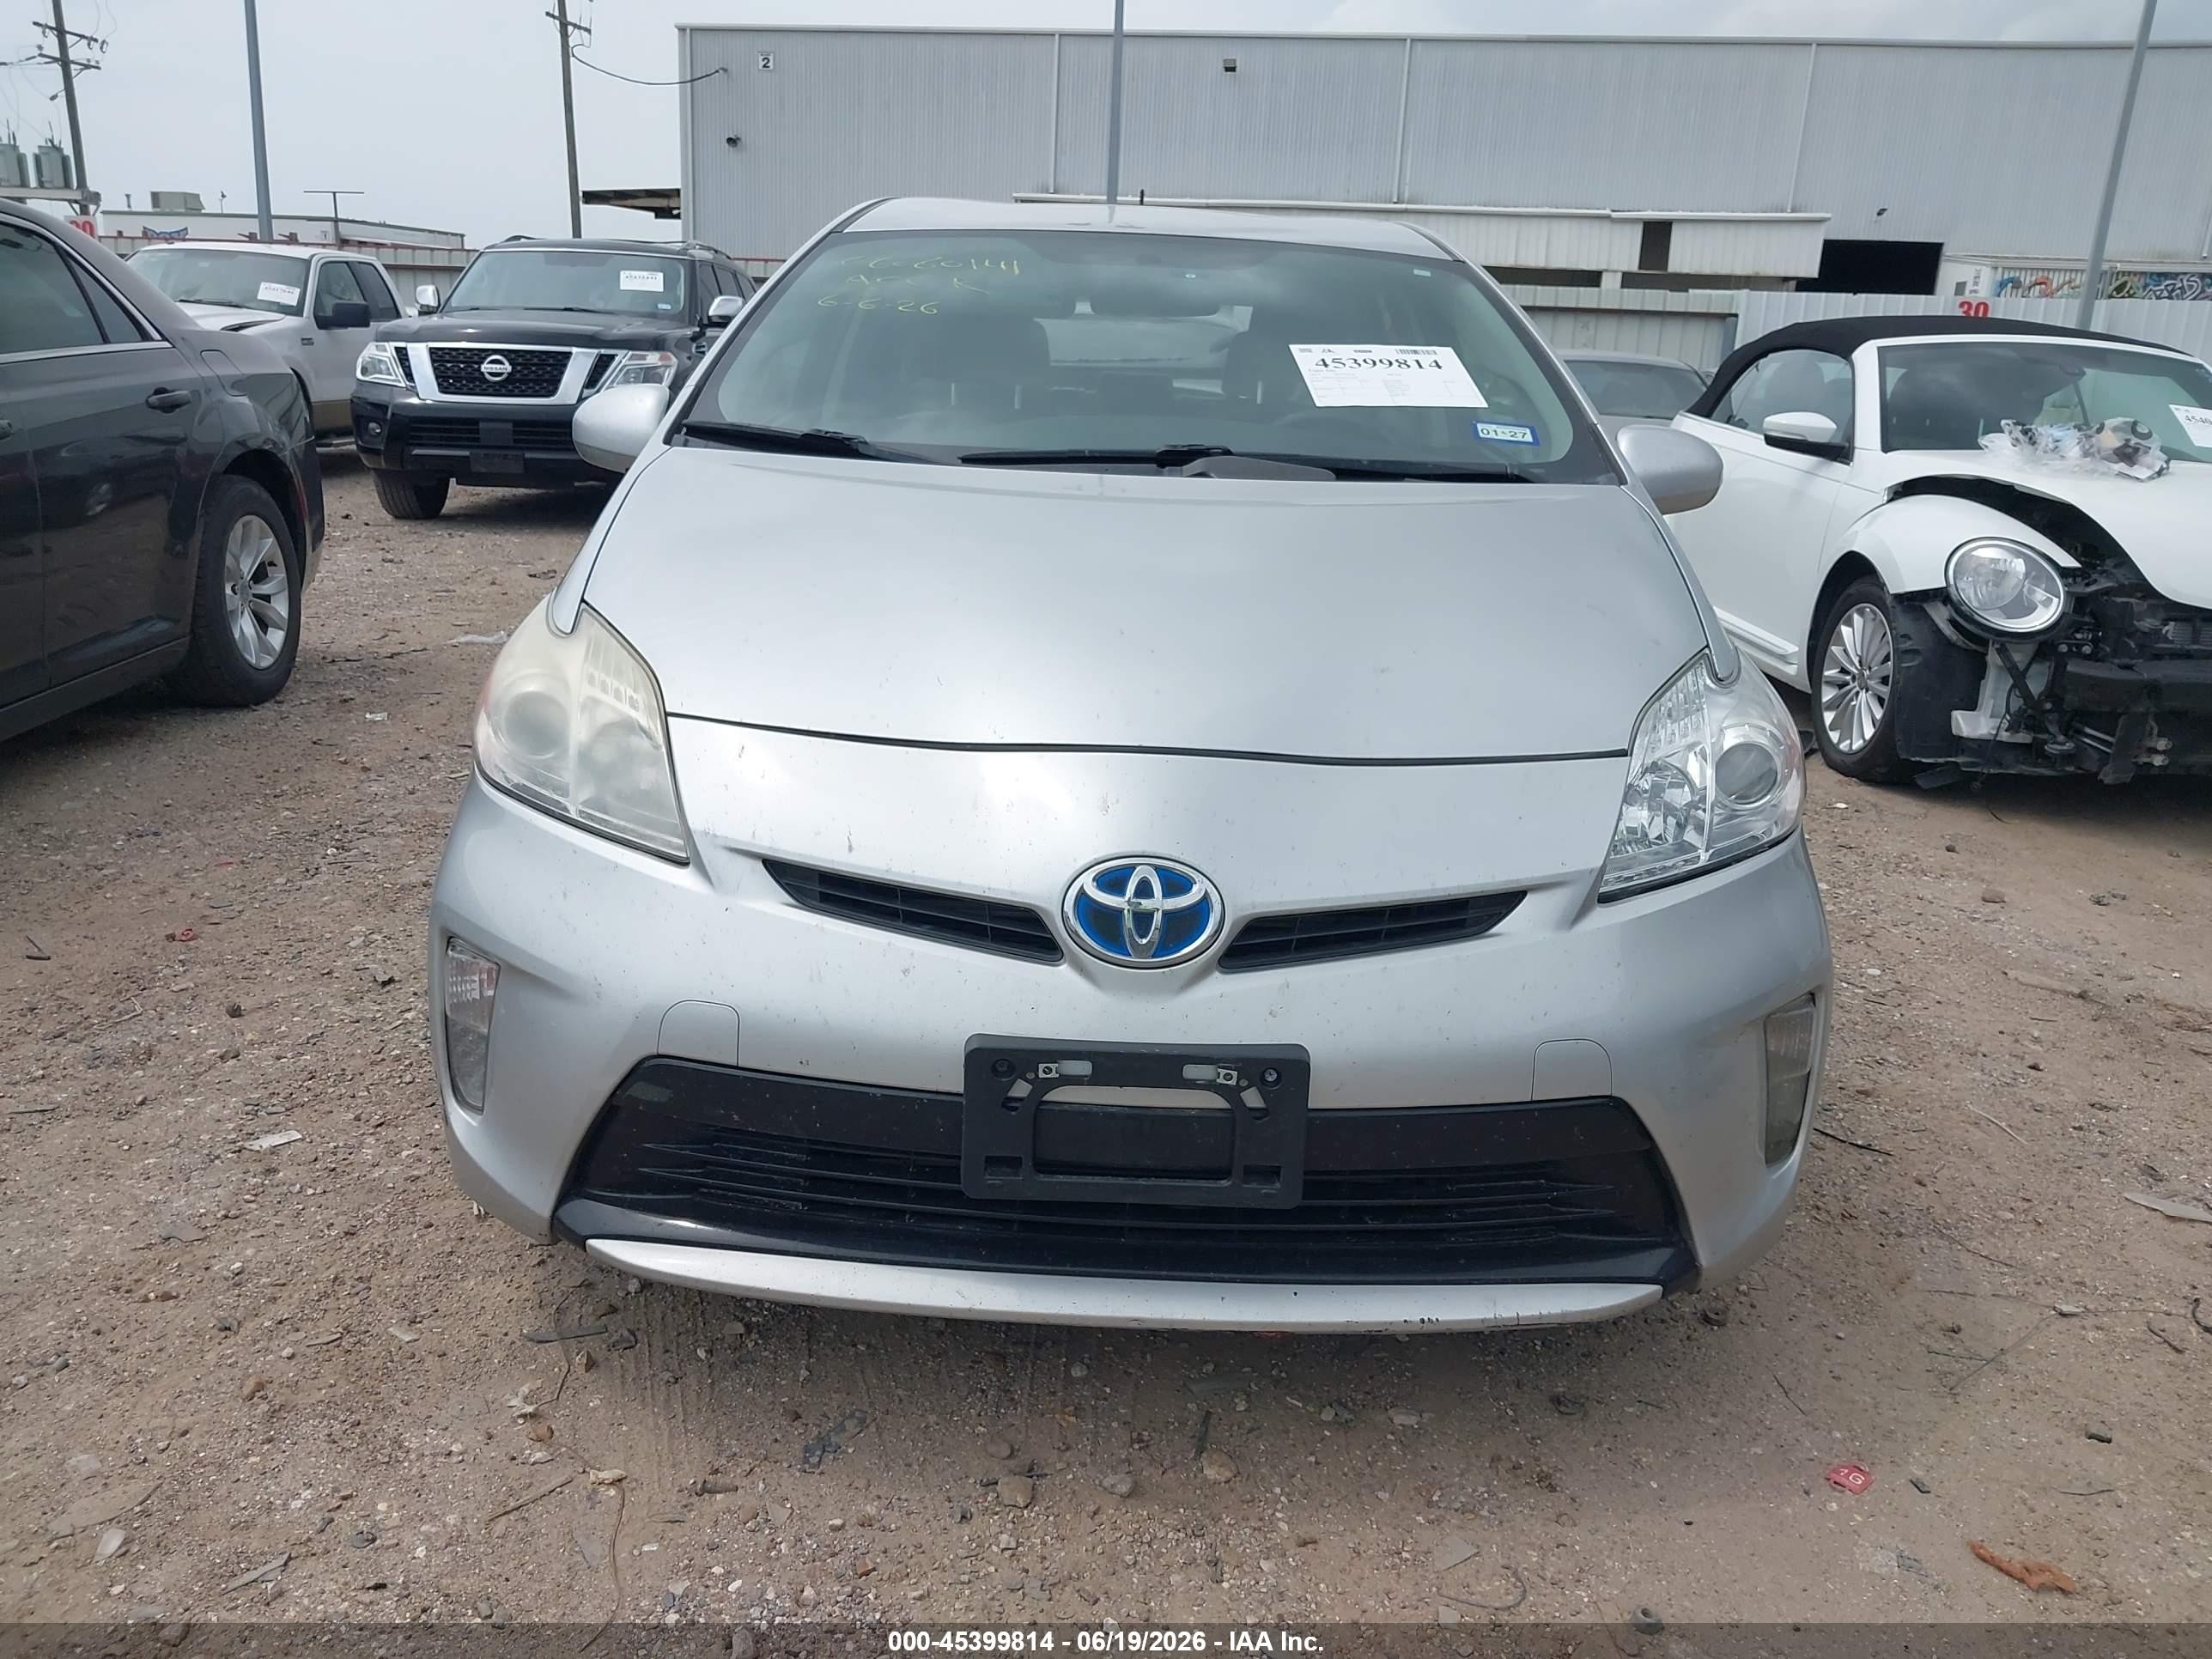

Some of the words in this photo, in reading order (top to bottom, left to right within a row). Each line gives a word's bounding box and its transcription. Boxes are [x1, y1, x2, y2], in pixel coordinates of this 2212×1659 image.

[762, 57, 770, 69] 2
[817, 295, 941, 315] 6-6-26
[1957, 301, 1990, 318] 30
[1315, 357, 1443, 371] 45399814
